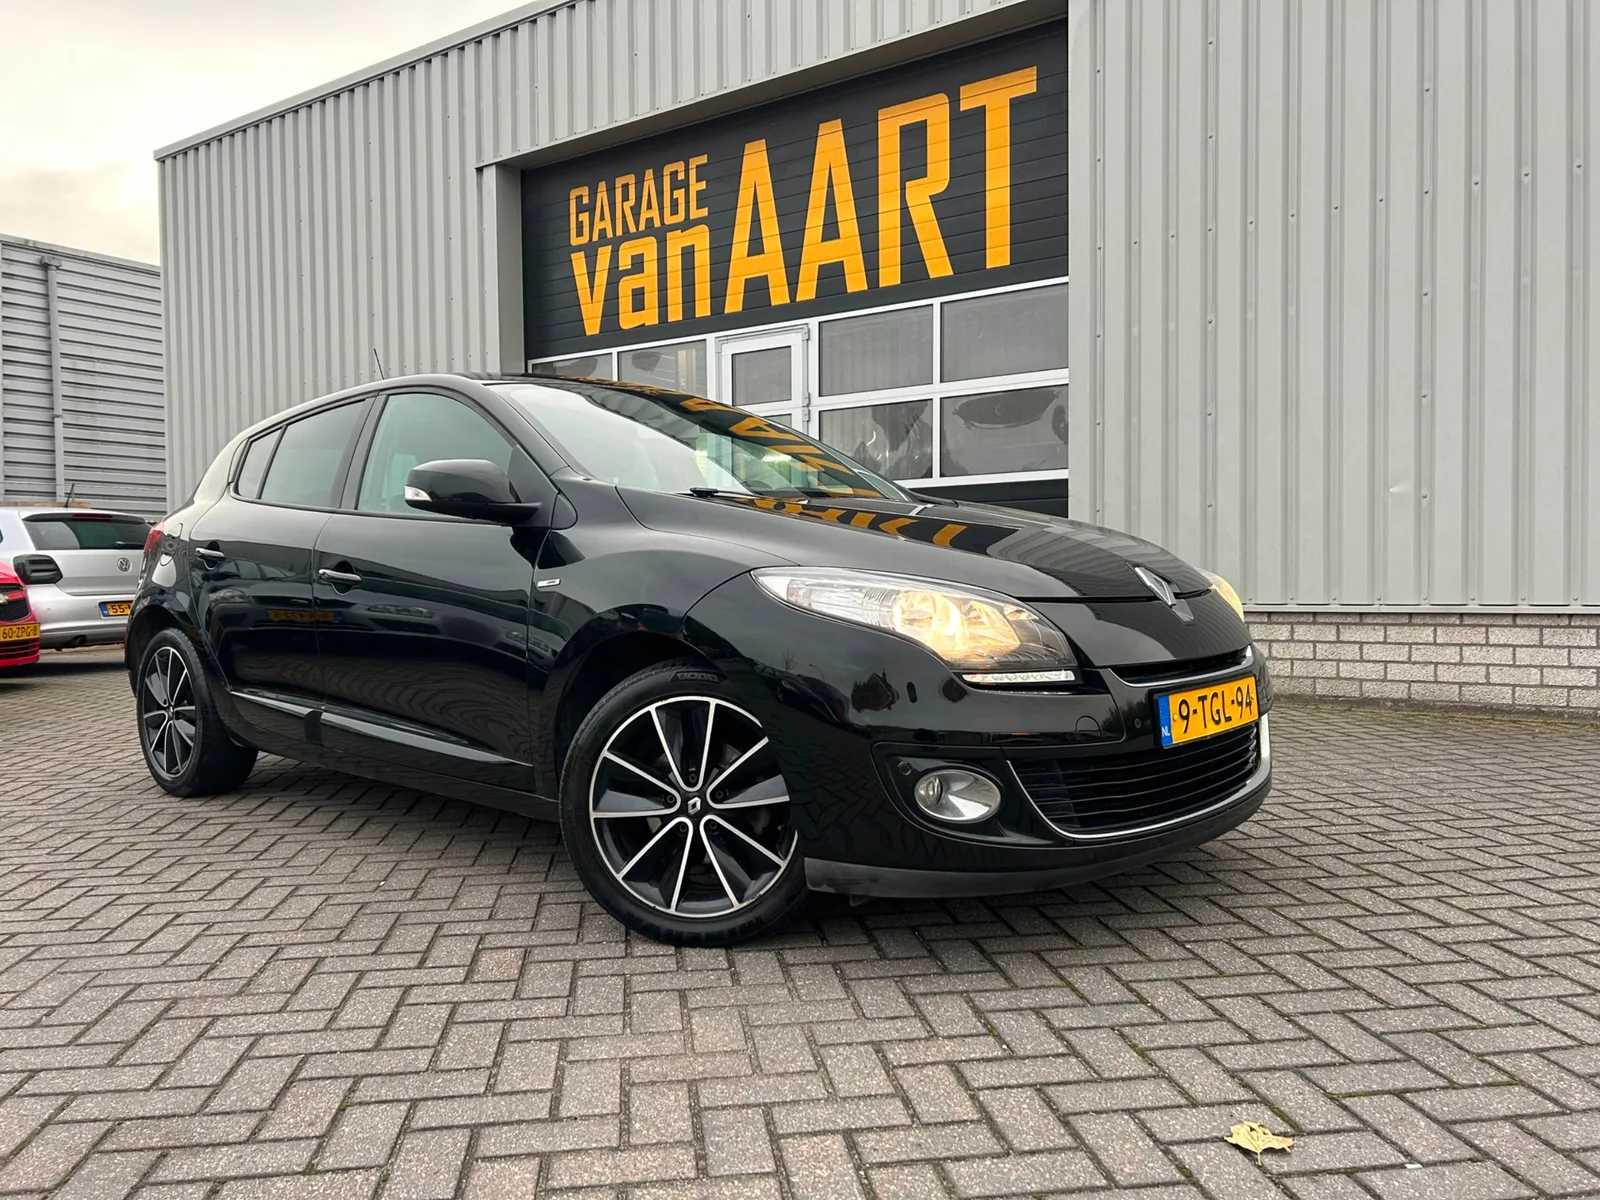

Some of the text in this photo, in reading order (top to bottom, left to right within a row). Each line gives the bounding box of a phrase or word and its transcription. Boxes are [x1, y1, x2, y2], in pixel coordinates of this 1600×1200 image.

[568, 153, 709, 247] GARAGE
[569, 65, 1038, 336] van AART
[2, 625, 38, 640] 60-ZPG-8
[1161, 683, 1253, 737] NL 9-TGL-94
